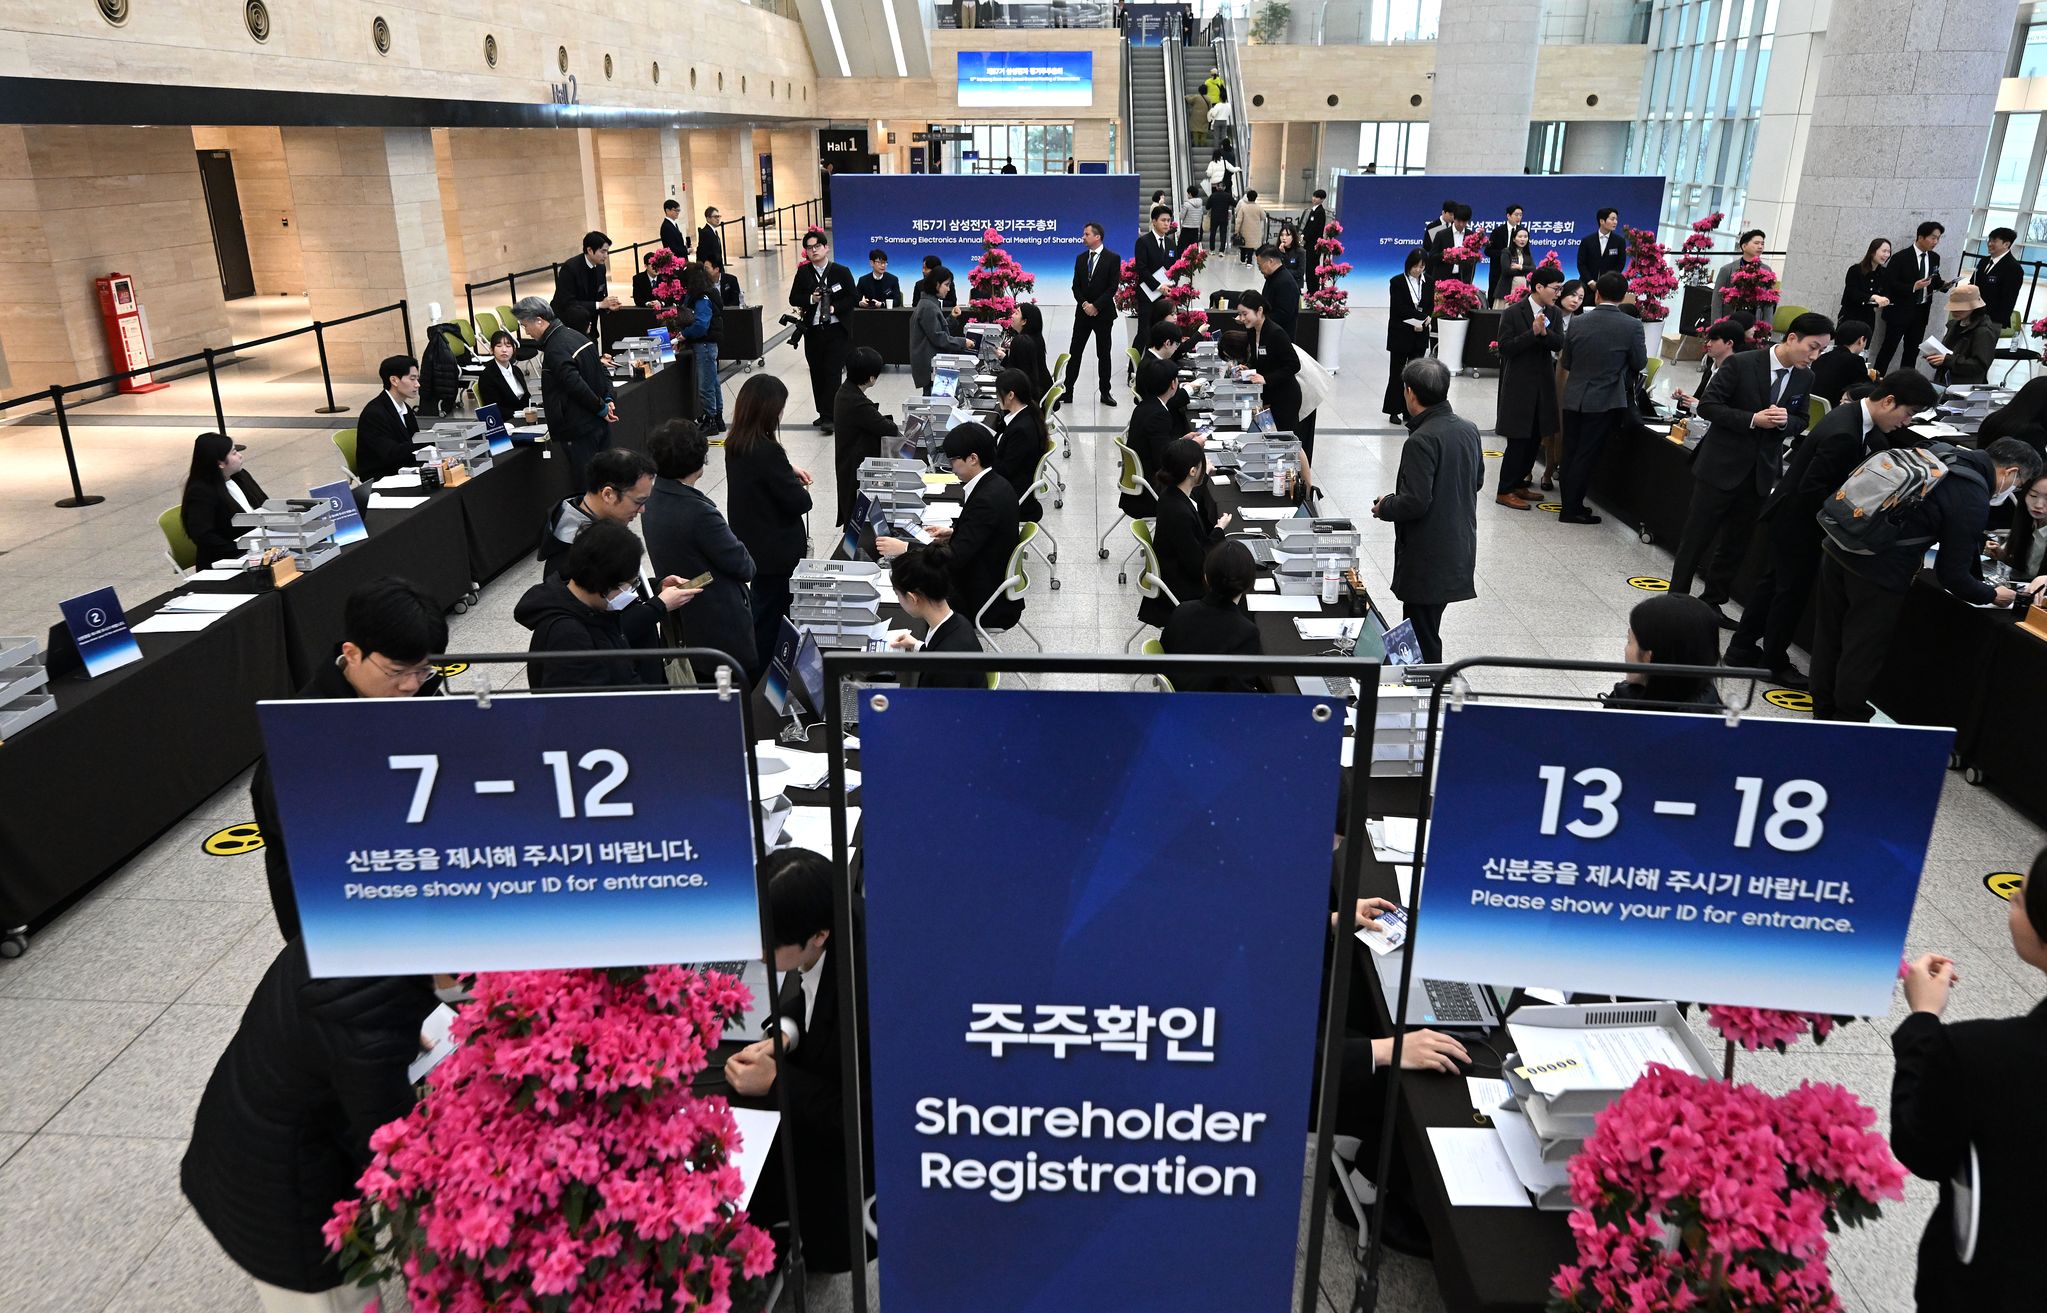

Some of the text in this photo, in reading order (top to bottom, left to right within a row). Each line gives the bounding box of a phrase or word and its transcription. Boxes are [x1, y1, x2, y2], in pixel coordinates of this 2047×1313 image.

[551, 74, 579, 104] Hall 2
[827, 137, 857, 152] Hall 1
[912, 219, 1057, 231] 제57기 삼성전자 정기주주총회
[870, 235, 883, 244] 57th
[884, 236, 917, 245] Samsung
[918, 236, 957, 244] Electronics
[958, 236, 983, 244] Annual
[1013, 236, 1042, 246] Meeting
[1043, 236, 1051, 244] of
[1394, 237, 1424, 246] Samsun
[1558, 238, 1567, 246] of
[331, 500, 339, 508] 3
[91, 612, 101, 624] 2
[1400, 646, 1409, 658] 14
[388, 748, 634, 823] 7 - 12
[1538, 765, 1829, 852] 13 - 18
[346, 839, 700, 872] 신분증을 제시해 주시기 바랍니다.
[344, 872, 709, 900] Please show your ID for entrance.
[1482, 857, 1855, 905] 신분증을 제시해 주시기 바랍니다.
[1471, 889, 1856, 934] Please show your ID for entrance.
[965, 1003, 1217, 1062] 주주확인
[915, 1097, 1267, 1142] Shareholder
[920, 1151, 1257, 1203] Registration
